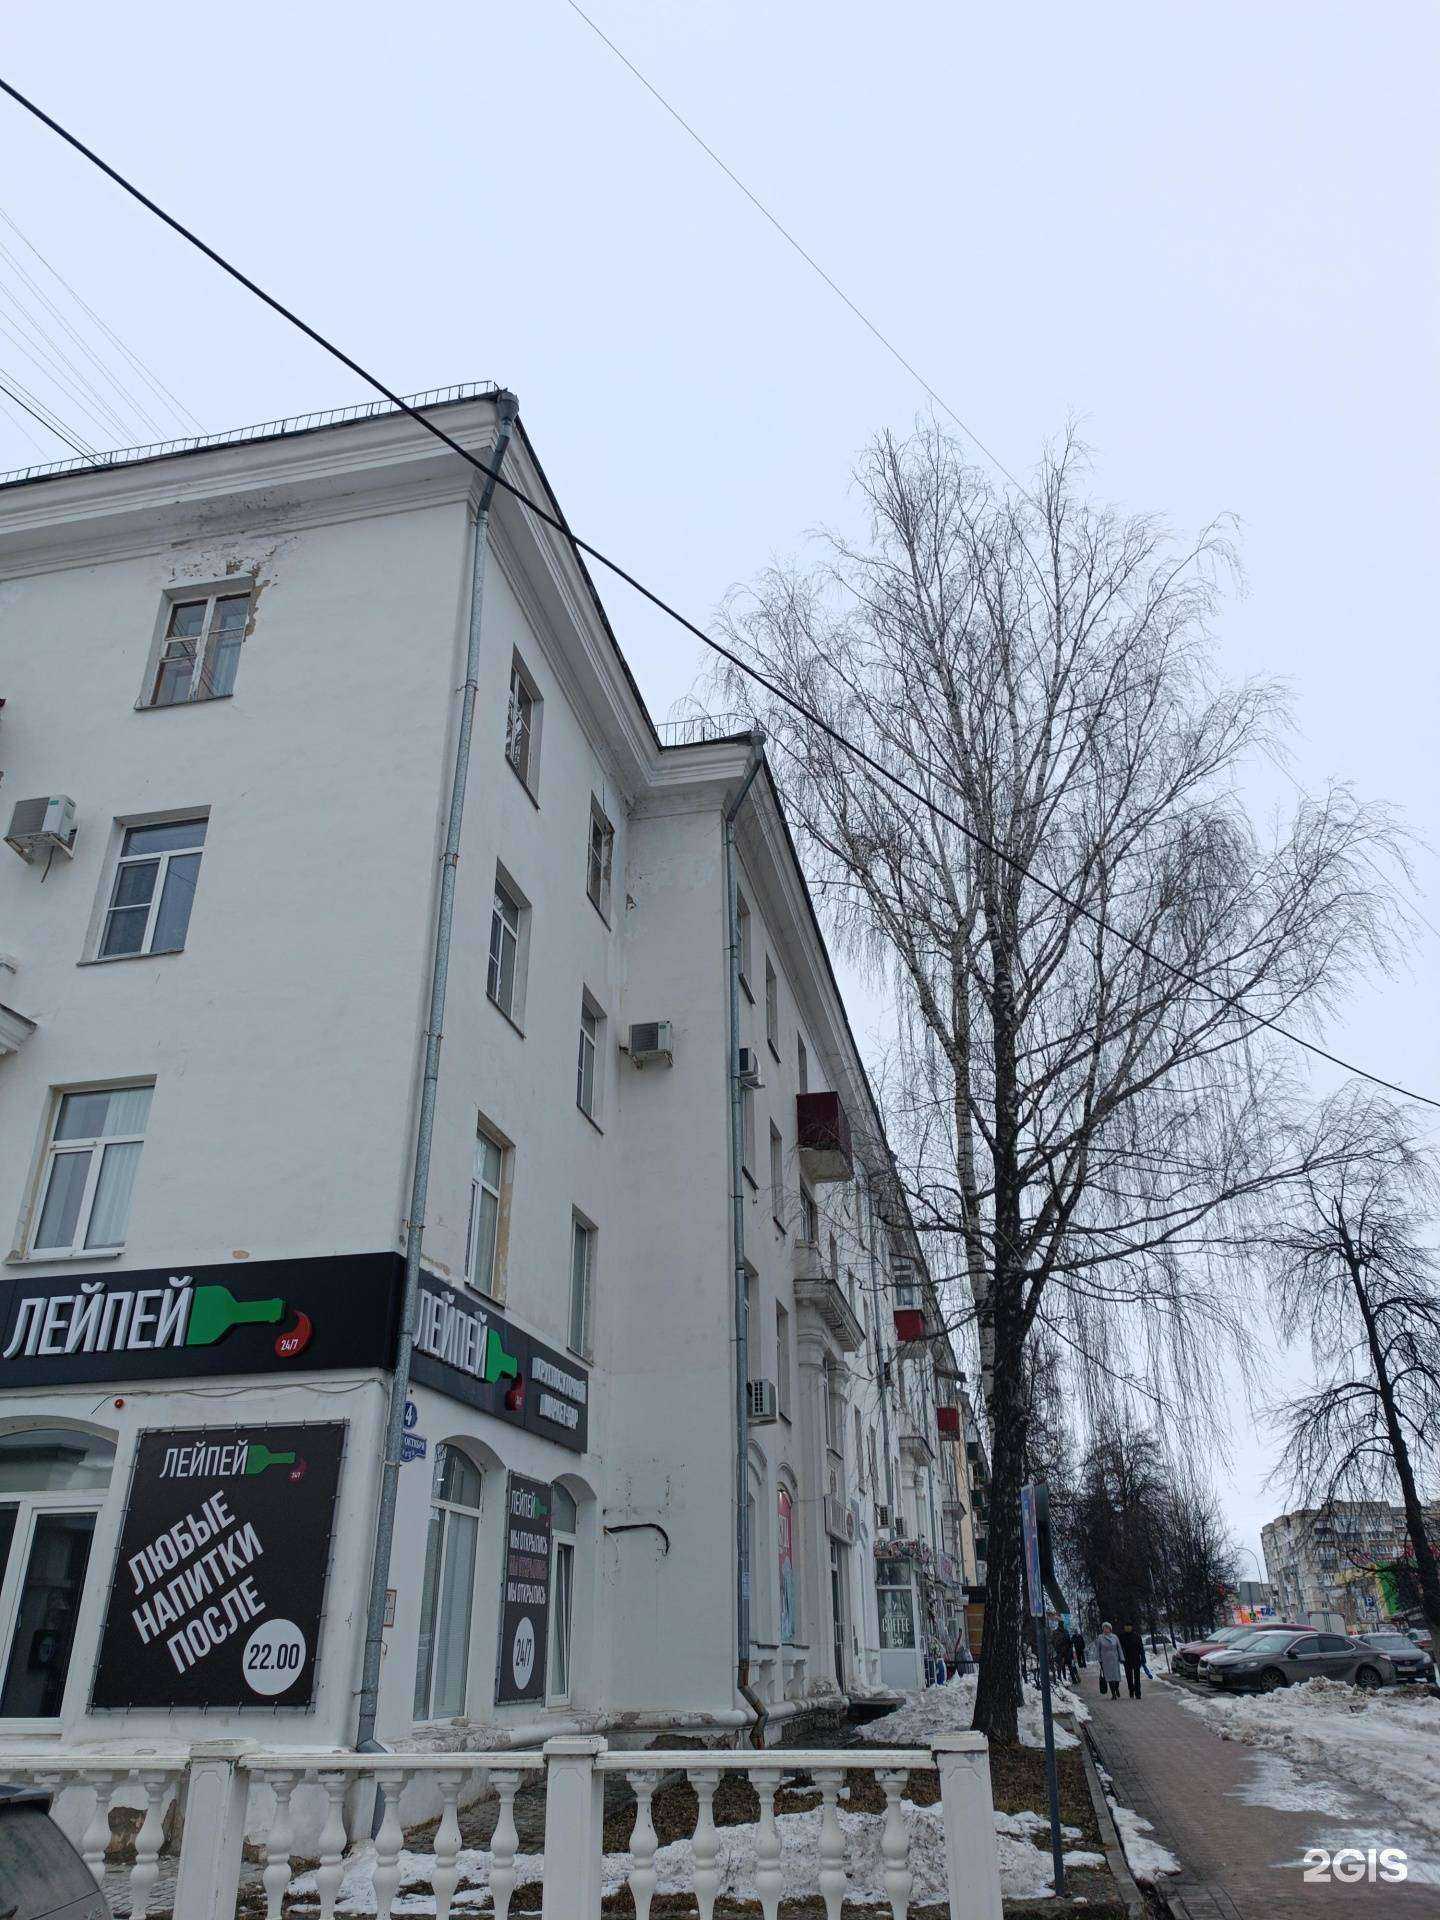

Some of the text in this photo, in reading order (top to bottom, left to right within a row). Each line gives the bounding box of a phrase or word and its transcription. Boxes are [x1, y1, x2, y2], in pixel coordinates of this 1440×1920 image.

[3, 1275, 193, 1359] ЛЕЙПЕЙ
[412, 1288, 488, 1379] ЛЕЙПЕЙ
[281, 1339, 299, 1351] 24/7
[405, 1405, 413, 1426] 4
[159, 1439, 249, 1478] ЛЕЙПЕЙ
[511, 1488, 536, 1519] ЛЕЙПЕЙ
[128, 1490, 236, 1595] ЛЮБЫЕ
[131, 1522, 264, 1645] НАПИТКИ
[166, 1575, 266, 1675] ПОСЛЕ
[882, 1617, 910, 1633] COFFEE
[248, 1643, 300, 1670] 22.00
[516, 1638, 533, 1668] 24/7
